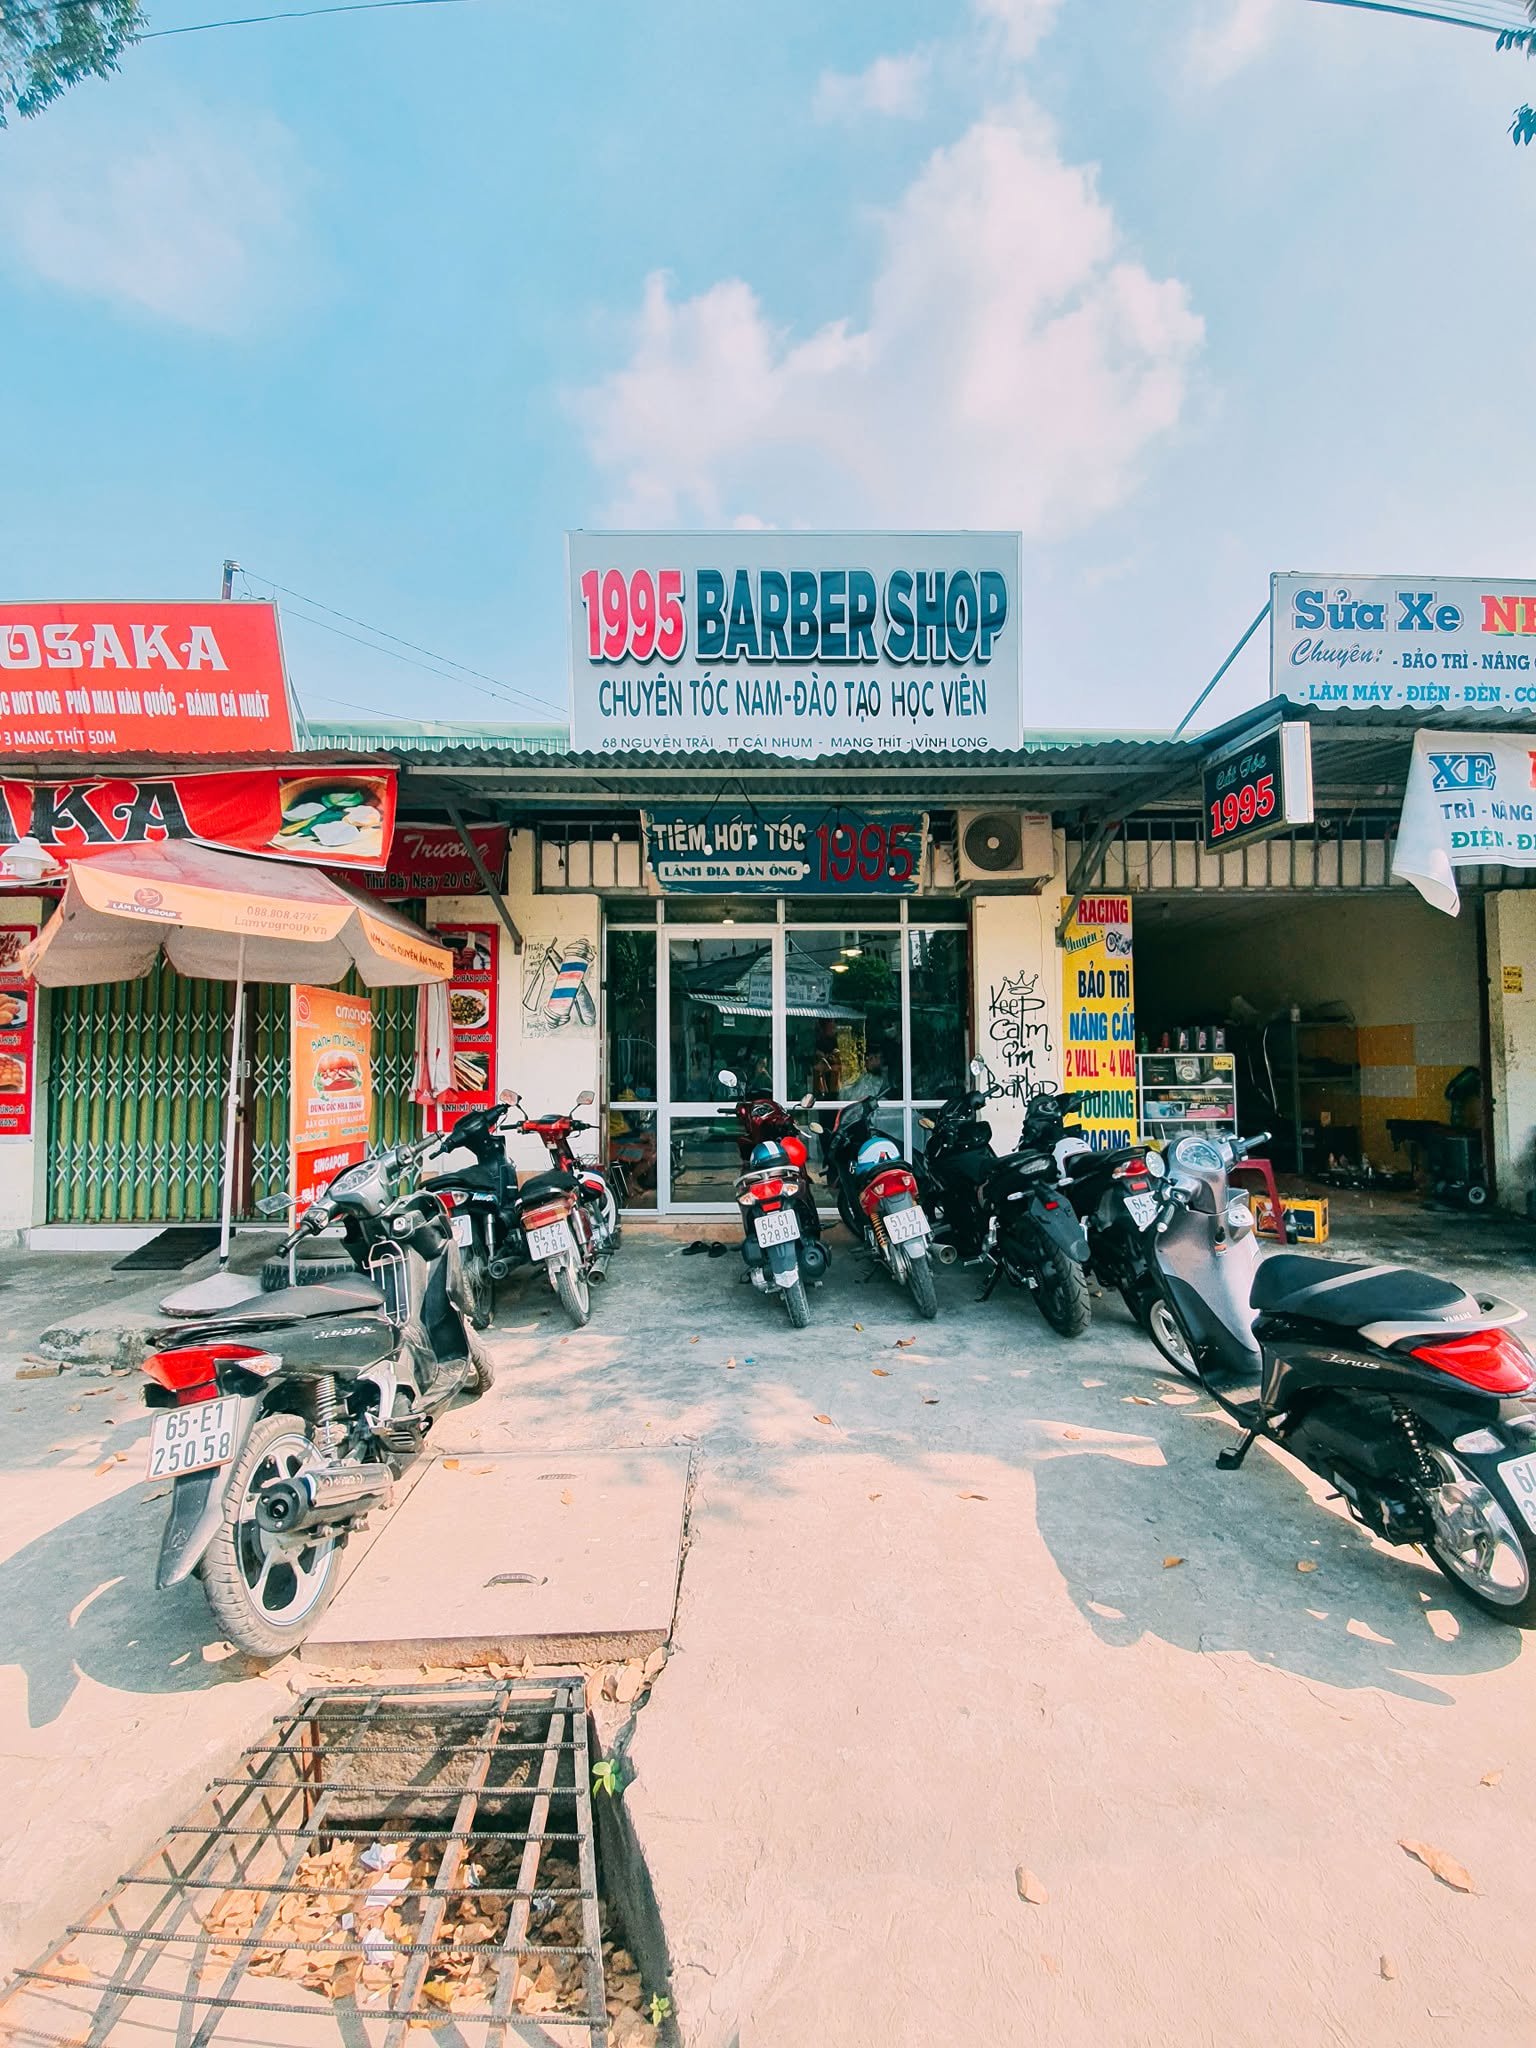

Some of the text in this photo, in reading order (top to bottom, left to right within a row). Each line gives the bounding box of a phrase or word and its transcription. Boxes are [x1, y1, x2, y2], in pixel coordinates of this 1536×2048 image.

[580, 569, 1010, 664] 1995 BARBER SHOP
[1293, 588, 1387, 632] Sửa
[1396, 592, 1463, 632] Xe
[1402, 648, 1437, 669] BẢO
[1441, 650, 1469, 669] TRÌ
[1481, 651, 1530, 670] NÂNG
[11, 690, 34, 714] HOT
[36, 689, 62, 714] DOG
[66, 686, 91, 714] PHÔ
[92, 690, 116, 714] MAI
[118, 687, 142, 715] HÀN
[144, 684, 177, 717] QUỐC
[185, 688, 219, 717] BÁNH
[221, 689, 238, 717] CÁ
[239, 690, 270, 722] NHẬT
[599, 672, 682, 717] CHUYÊN
[690, 671, 728, 717] TÓC
[844, 680, 881, 723] TẠO
[891, 680, 934, 725] HỌC
[941, 672, 987, 717] VIÊN
[1309, 681, 1347, 701] LÀM
[1352, 681, 1393, 701] MÁY
[1406, 682, 1450, 704] ĐIỆN
[1464, 681, 1500, 702] ĐÈN
[14, 730, 54, 745] MANG
[55, 727, 85, 745] THÍT
[602, 737, 617, 748] 68
[727, 737, 739, 748] TT
[772, 737, 812, 748] NHUM
[831, 737, 874, 748] MANG
[951, 737, 988, 748] LONG
[1427, 752, 1496, 792] XE
[1211, 773, 1275, 837] 1995
[1440, 798, 1475, 819] TRÌ
[1491, 800, 1533, 821] NÂNG
[652, 814, 915, 882] TIỆM HỚT TÓC 1995
[1451, 826, 1504, 850] ĐIỆN
[769, 863, 797, 876] ÔNG
[1078, 899, 1128, 923] RACING
[1078, 960, 1130, 998] BẢO TRÌ
[1069, 1006, 1108, 1041] NÂNG
[1065, 1049, 1072, 1077] 2
[1075, 1049, 1099, 1077] VALL
[1109, 1049, 1116, 1077] 4
[1076, 1090, 1134, 1119] TOURING
[894, 1221, 923, 1240] 2227
[535, 1240, 566, 1257] 1284
[1322, 1353, 1381, 1370] Janus
[152, 1431, 231, 1476] 250.58
